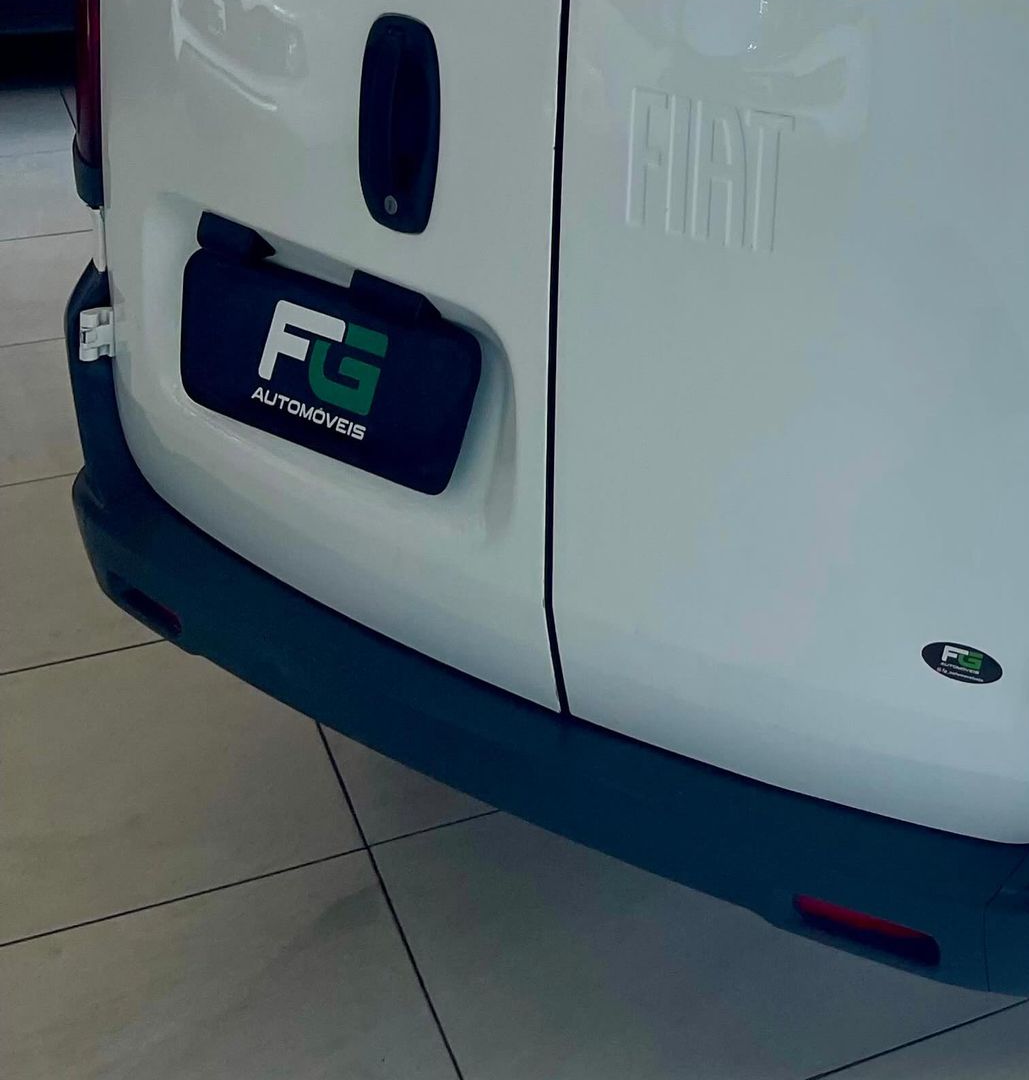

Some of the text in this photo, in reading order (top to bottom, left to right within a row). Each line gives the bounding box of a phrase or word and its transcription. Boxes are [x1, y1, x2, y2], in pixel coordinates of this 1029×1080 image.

[626, 85, 795, 253] FIAT
[258, 299, 389, 416] FG
[251, 386, 367, 441] AUTOMÓVEIS
[941, 644, 984, 670] FG
